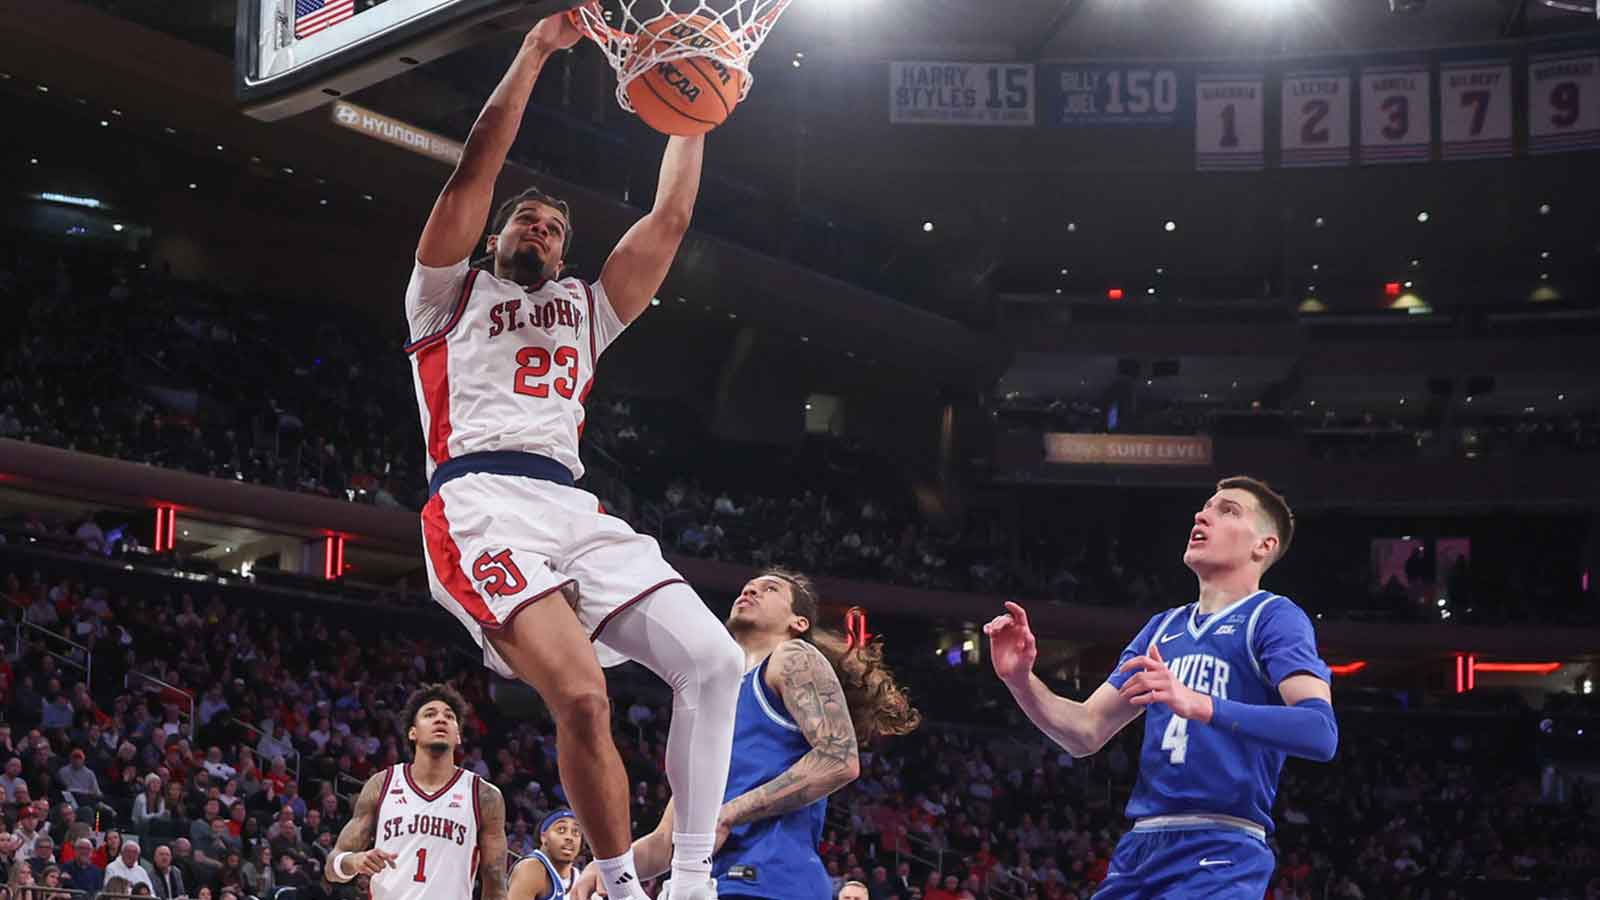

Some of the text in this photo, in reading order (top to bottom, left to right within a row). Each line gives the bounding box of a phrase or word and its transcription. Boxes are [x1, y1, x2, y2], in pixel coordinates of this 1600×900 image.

[657, 62, 701, 103] NCAA
[895, 87, 976, 107] STYLES
[901, 65, 968, 87] HARRY
[985, 66, 1026, 109] 15
[1103, 71, 1177, 113] 150
[1218, 103, 1239, 149] 1
[1301, 99, 1329, 145] 2
[1380, 95, 1408, 140] 3
[1459, 90, 1491, 137] 7
[1550, 80, 1580, 129] 9
[362, 115, 430, 150] HYUNDAI
[489, 299, 525, 338] ST.
[513, 346, 579, 400] 23
[1105, 442, 1153, 458] SUITE
[1157, 442, 1206, 458] LEVEL
[472, 548, 528, 598] SJ
[1163, 654, 1231, 701] AVIER
[1161, 713, 1190, 764] 4
[383, 814, 467, 846] ST. JOHN'S
[413, 848, 427, 883] 1
